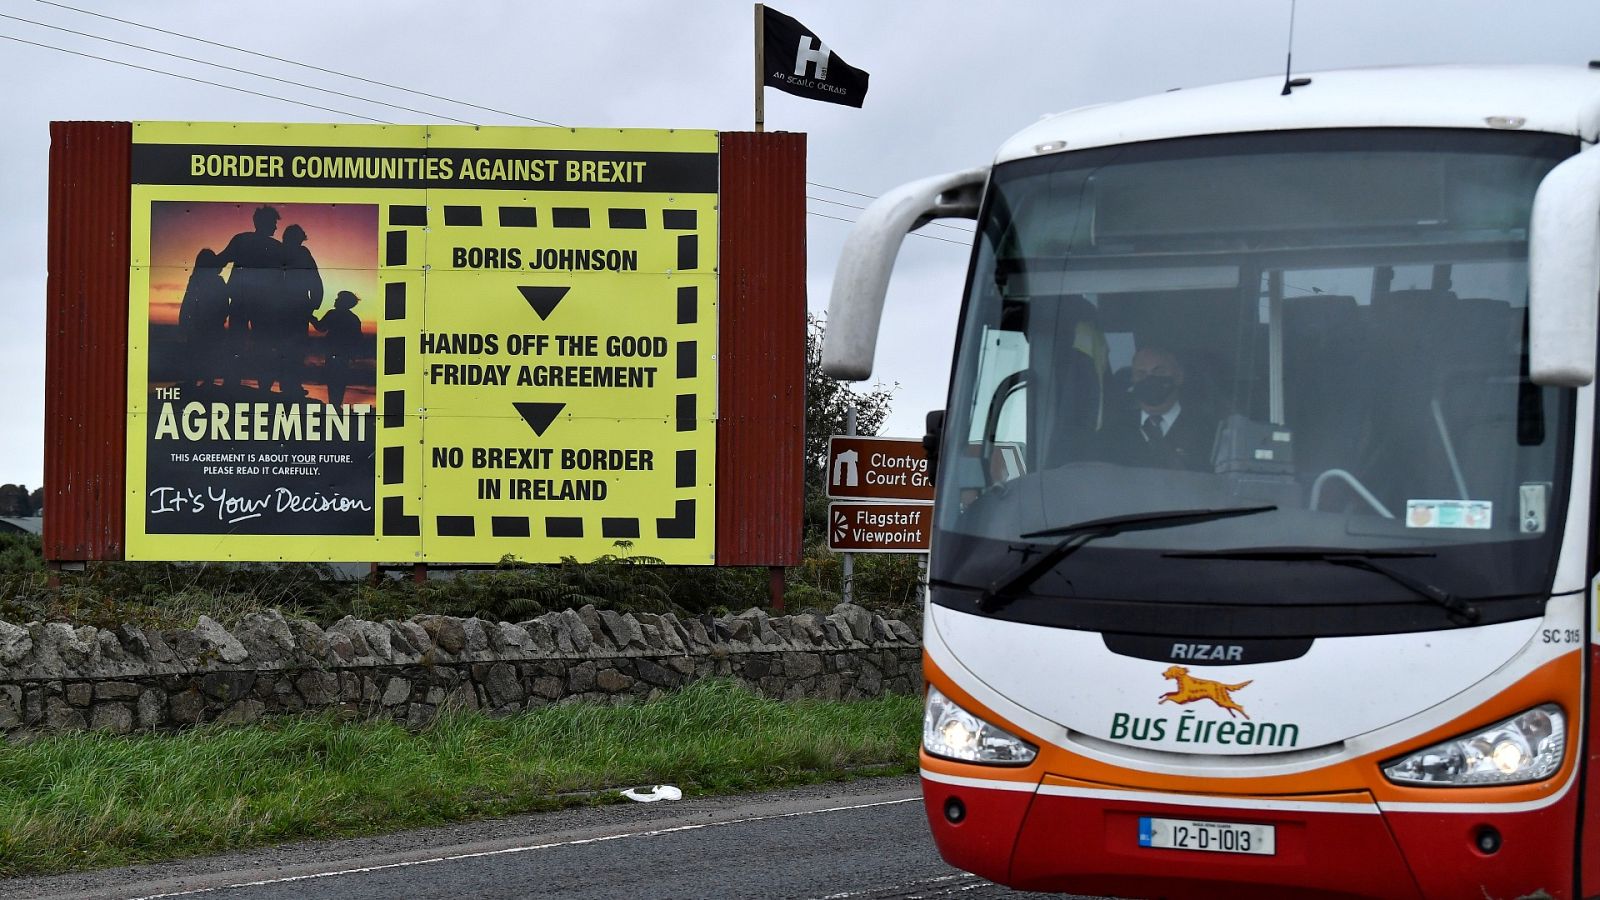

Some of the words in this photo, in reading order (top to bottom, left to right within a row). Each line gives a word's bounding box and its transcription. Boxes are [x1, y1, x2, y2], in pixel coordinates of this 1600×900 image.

[190, 154, 284, 178] BORDER
[291, 155, 454, 180] COMMUNITIES
[458, 159, 559, 182] AGAINST
[566, 160, 647, 183] BREXIT
[452, 246, 522, 269] BORIS
[528, 247, 638, 272] JOHNSON
[420, 332, 499, 355] HANDS
[506, 334, 549, 356] OFF
[554, 335, 598, 357] THE
[606, 336, 668, 358] GOOD
[430, 363, 511, 386] FRIDAY
[516, 365, 658, 388] AGREEMENT
[155, 387, 181, 400] THE
[154, 401, 371, 442] AGREEMENT
[171, 453, 190, 462] THIS
[192, 453, 246, 463] AGREEMENT
[247, 453, 256, 463] IS
[258, 454, 289, 463] ABOUT
[291, 454, 316, 464] YOUR
[318, 454, 353, 464] FUTURE.
[432, 447, 464, 469] NO
[472, 448, 553, 470] BREXIT
[561, 449, 654, 471] BORDER
[203, 466, 234, 475] PLEASE
[236, 466, 260, 475] READ
[262, 466, 269, 475] IT
[272, 466, 321, 476] CAREFULLY.
[865, 470, 907, 486] Court
[477, 478, 501, 500] IN
[509, 478, 608, 501] IRELAND
[150, 486, 205, 514] It's
[207, 486, 271, 521] Your
[275, 486, 371, 513] Decision
[856, 510, 921, 528] Flagstaff
[852, 528, 922, 545] Viewpoint
[1542, 629, 1561, 643] SC
[1564, 629, 1580, 643] 315
[1170, 643, 1243, 661] RIZAR
[1109, 712, 1167, 741] Bus
[1173, 826, 1251, 851] 12-D-1013
